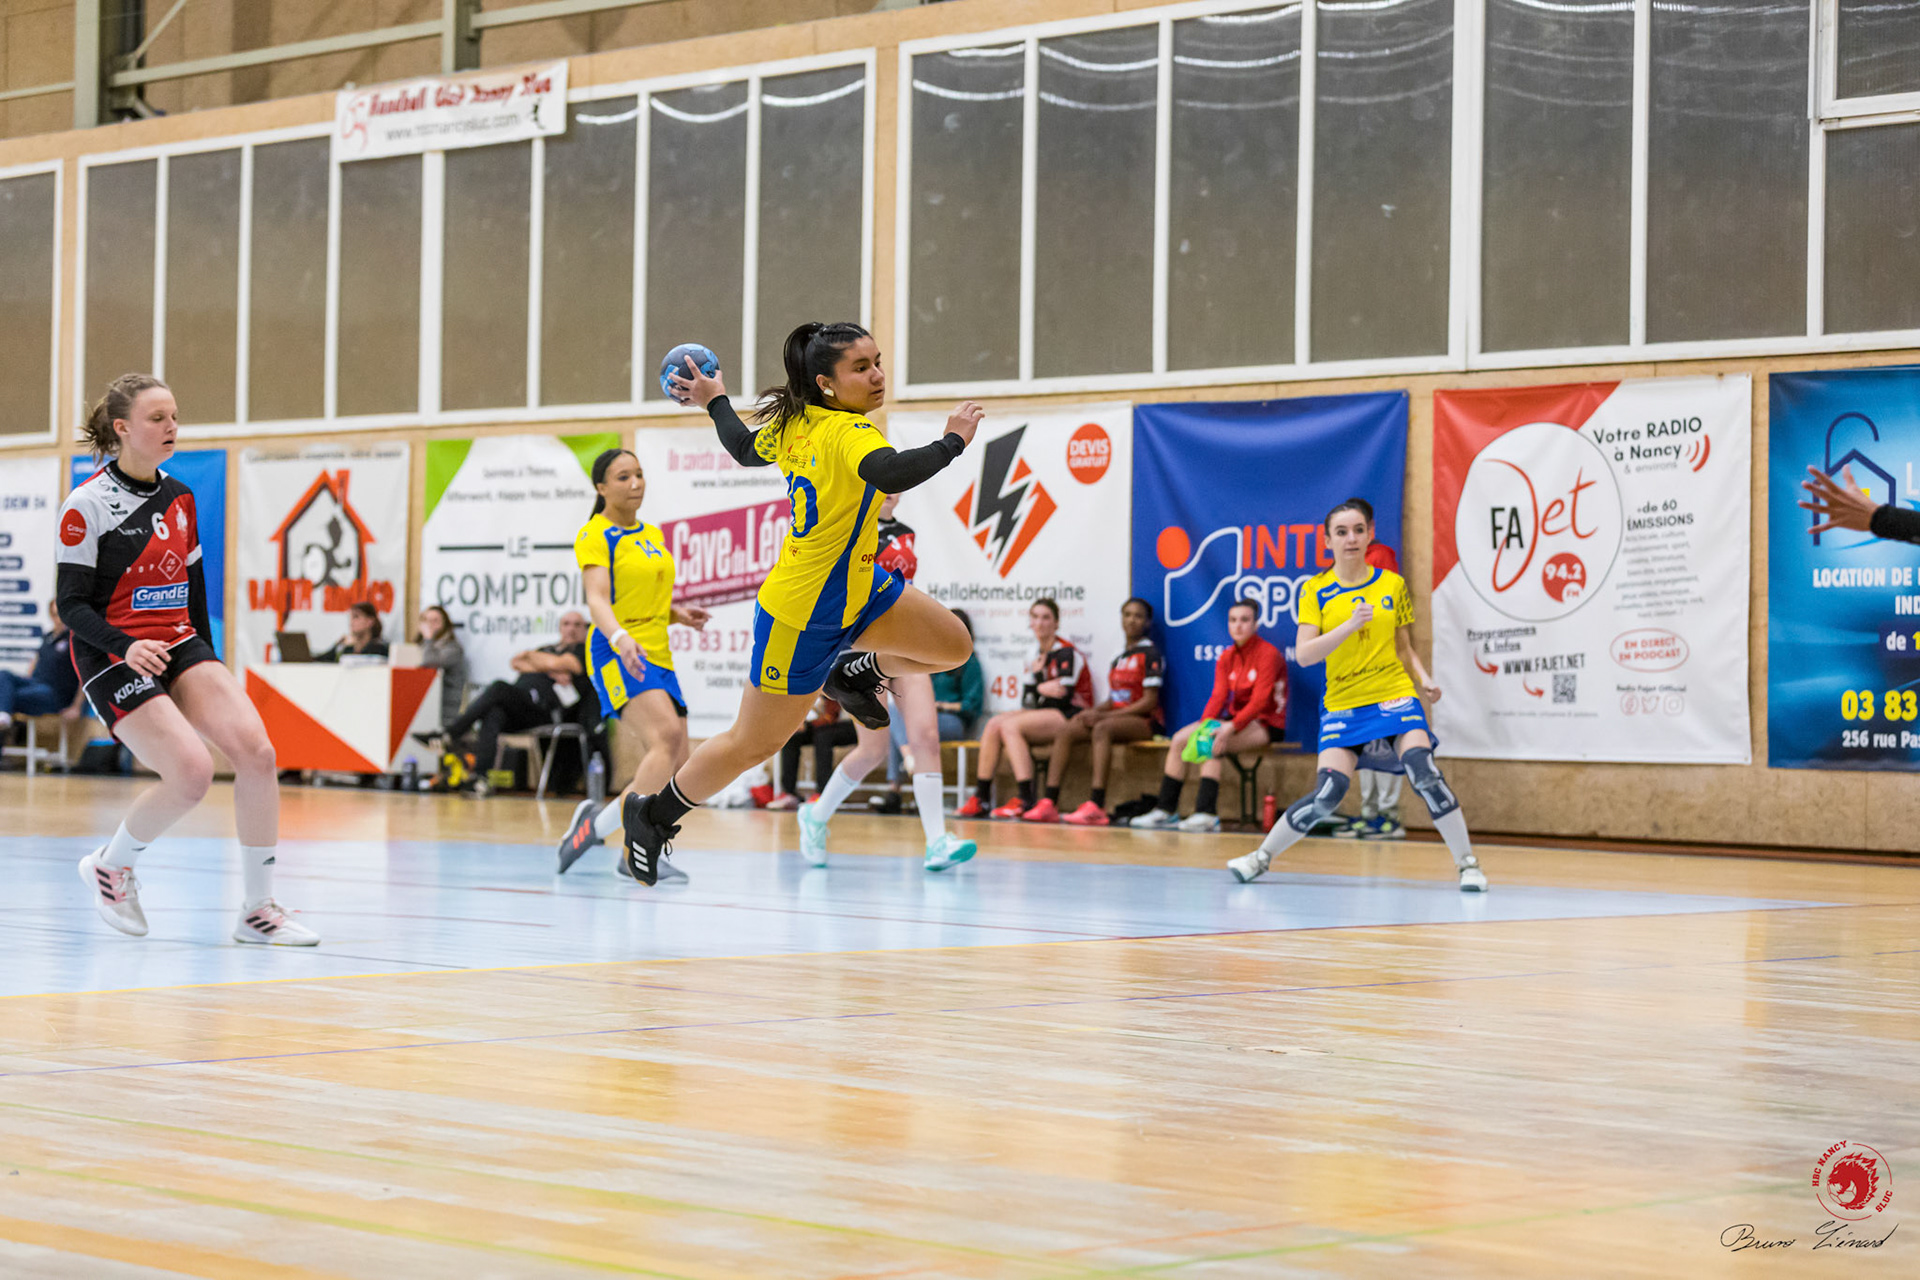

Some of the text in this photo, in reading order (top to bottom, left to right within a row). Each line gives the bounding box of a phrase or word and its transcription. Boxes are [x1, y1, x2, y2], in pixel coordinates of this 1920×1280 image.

[1593, 416, 1702, 444] Votre RADIO
[1070, 438, 1109, 456] DEVIS
[1614, 444, 1682, 461] à Nancy
[1070, 456, 1108, 468] GRATUIT
[1662, 499, 1677, 511] 60
[151, 512, 170, 540] 6
[1627, 513, 1694, 531] ÉMISSIONS
[508, 536, 528, 558] LE
[635, 540, 662, 558] 14
[673, 521, 732, 586] Cave
[746, 504, 791, 572] Léo
[1544, 563, 1582, 580] 94.2
[1813, 567, 1912, 588] LOCATION DE
[927, 581, 1086, 601] HelloHomeLorraine
[671, 629, 749, 652] 03 83 17
[1467, 627, 1536, 641] Programmes
[1624, 637, 1676, 649] EN DIRECT
[1886, 631, 1906, 651] de
[1484, 642, 1490, 653] &
[1619, 648, 1680, 661] EN PODCAST
[1504, 653, 1585, 674] WWW.FAJET.NET
[1841, 689, 1918, 721] 03 83
[1842, 730, 1869, 748] 256
[1873, 733, 1897, 748] rue
